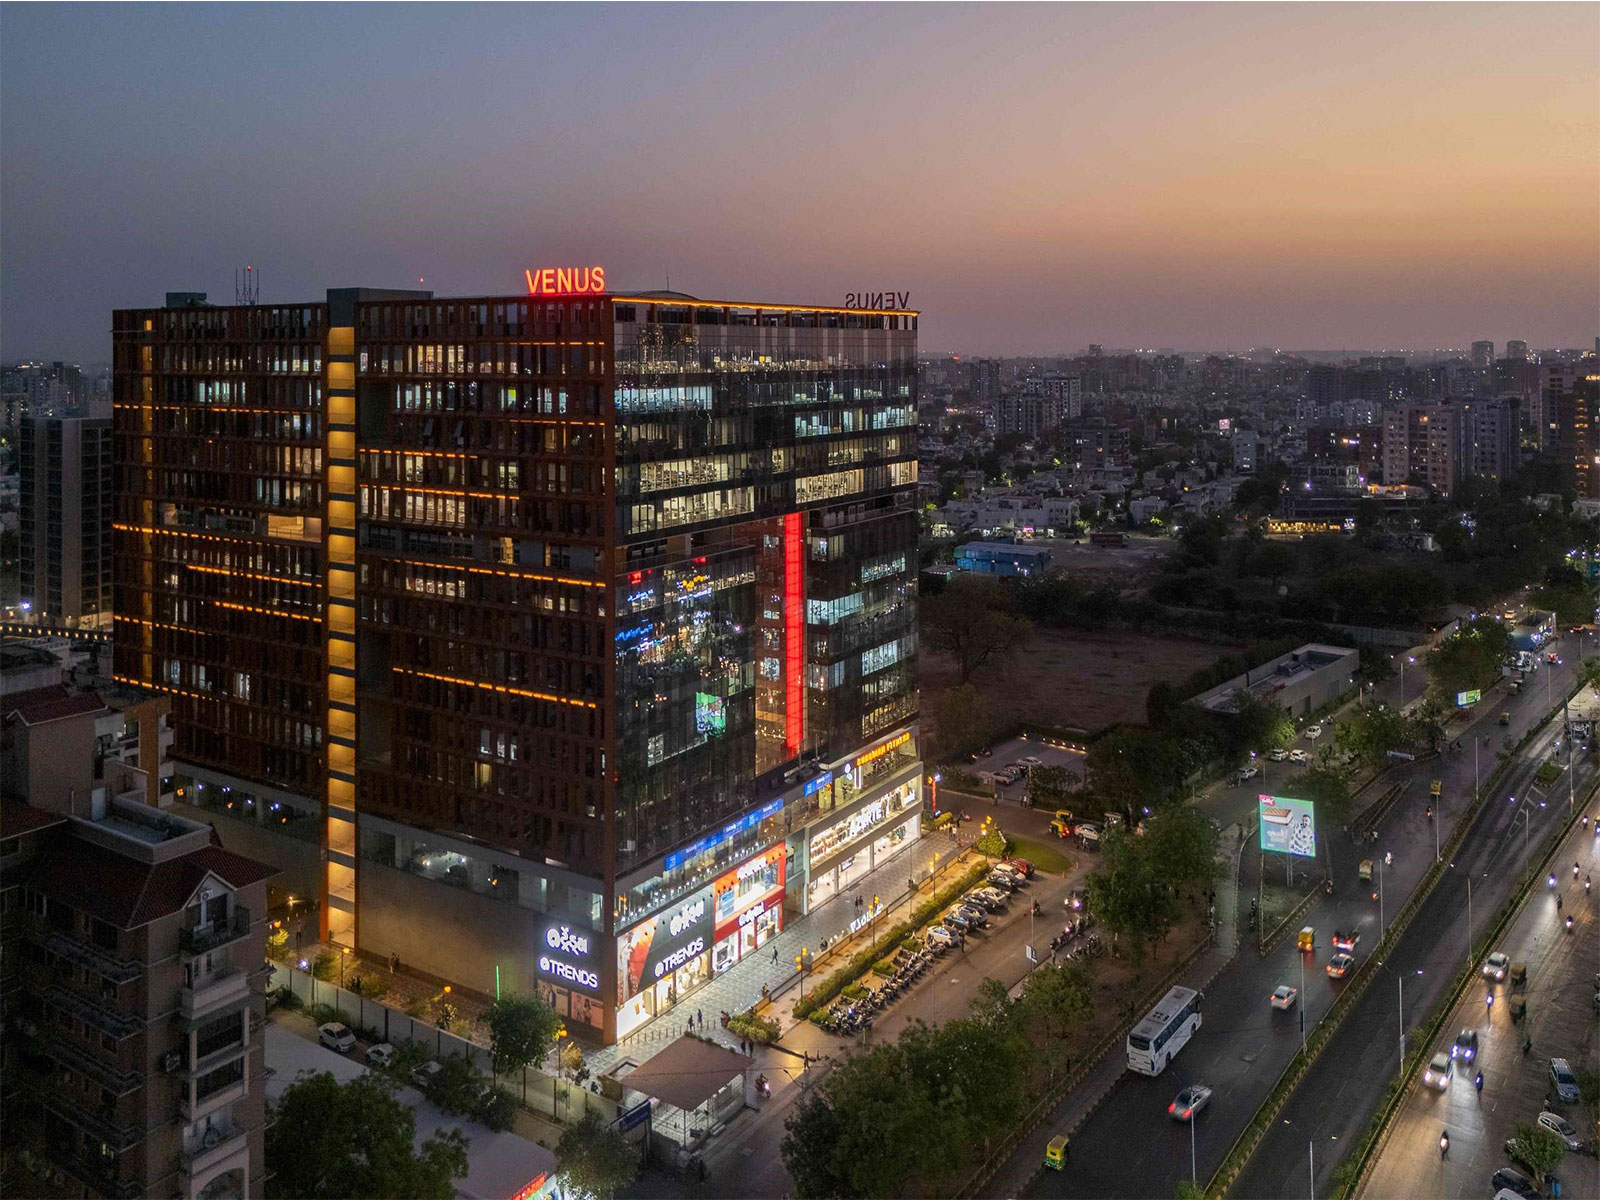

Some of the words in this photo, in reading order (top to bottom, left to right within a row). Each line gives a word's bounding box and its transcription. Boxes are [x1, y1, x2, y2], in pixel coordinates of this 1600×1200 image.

[525, 266, 605, 294] VENUS
[662, 936, 704, 972] TRENDS
[549, 958, 599, 989] TRENDS
